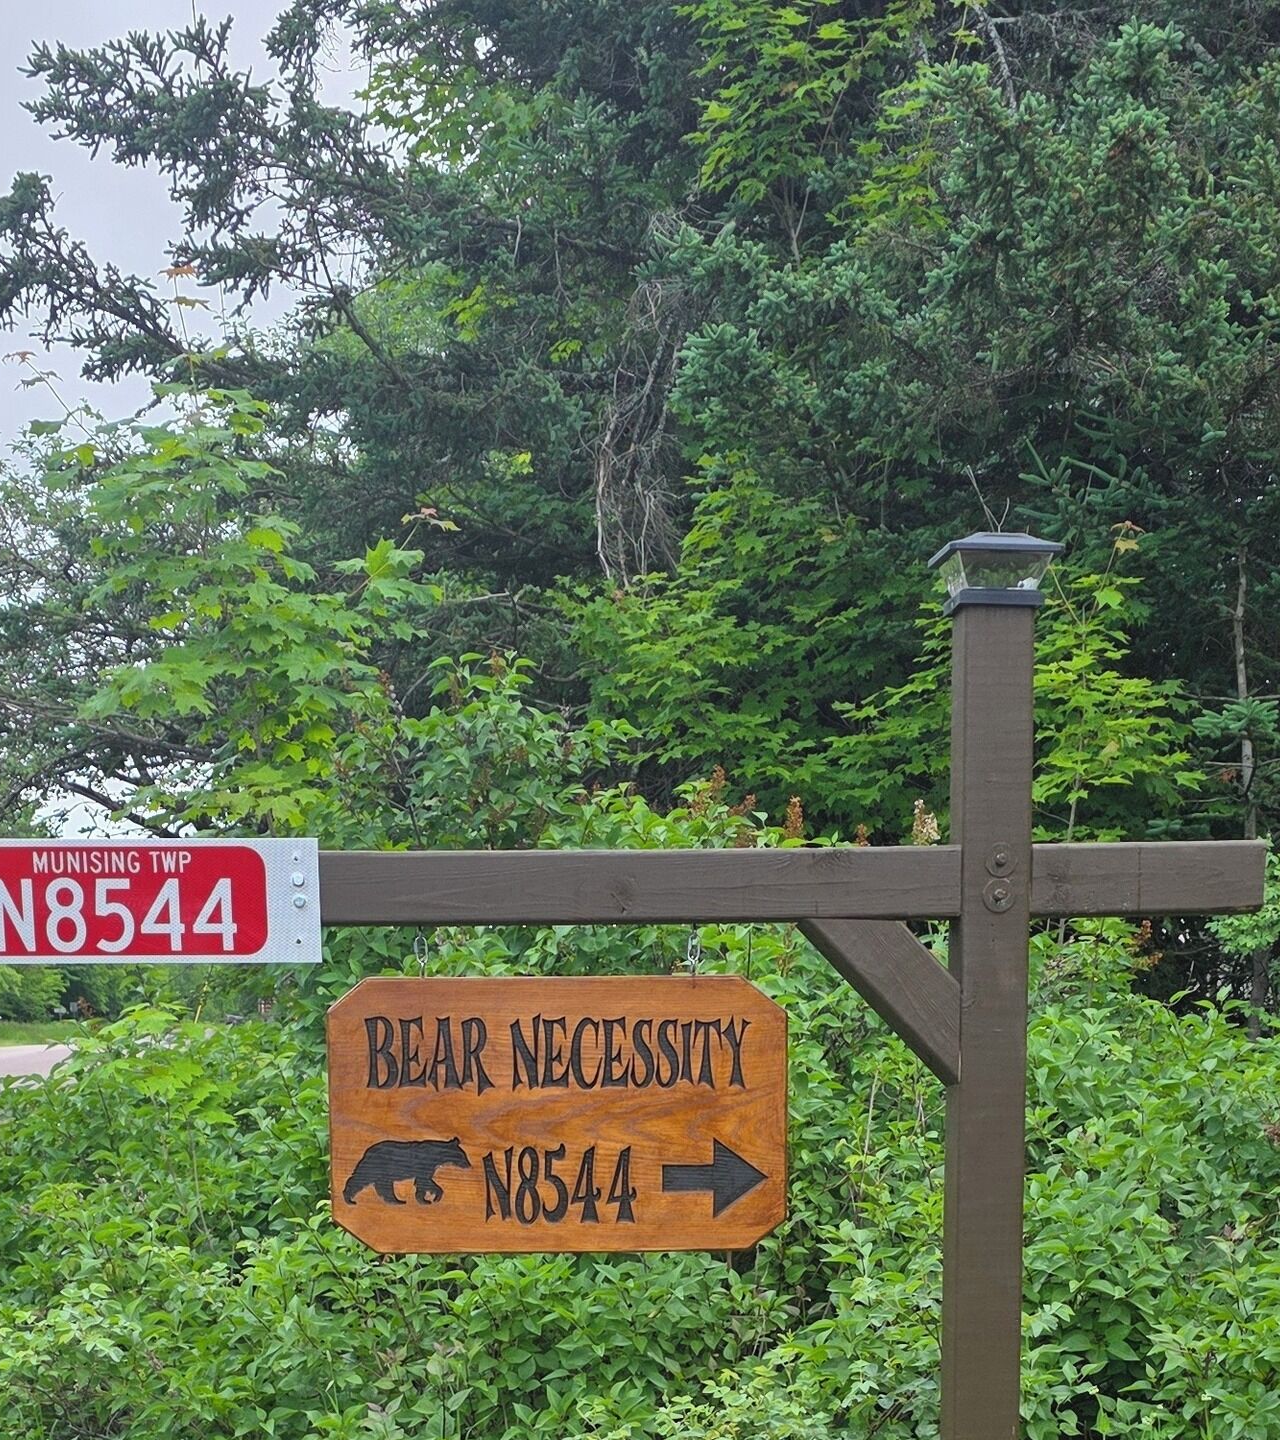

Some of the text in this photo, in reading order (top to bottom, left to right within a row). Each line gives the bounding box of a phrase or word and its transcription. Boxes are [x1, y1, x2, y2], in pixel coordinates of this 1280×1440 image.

[32, 850, 192, 874] MUNISING TWP
[364, 1013, 752, 1096] BEAR NECESSITY
[482, 1143, 638, 1225] N8544
